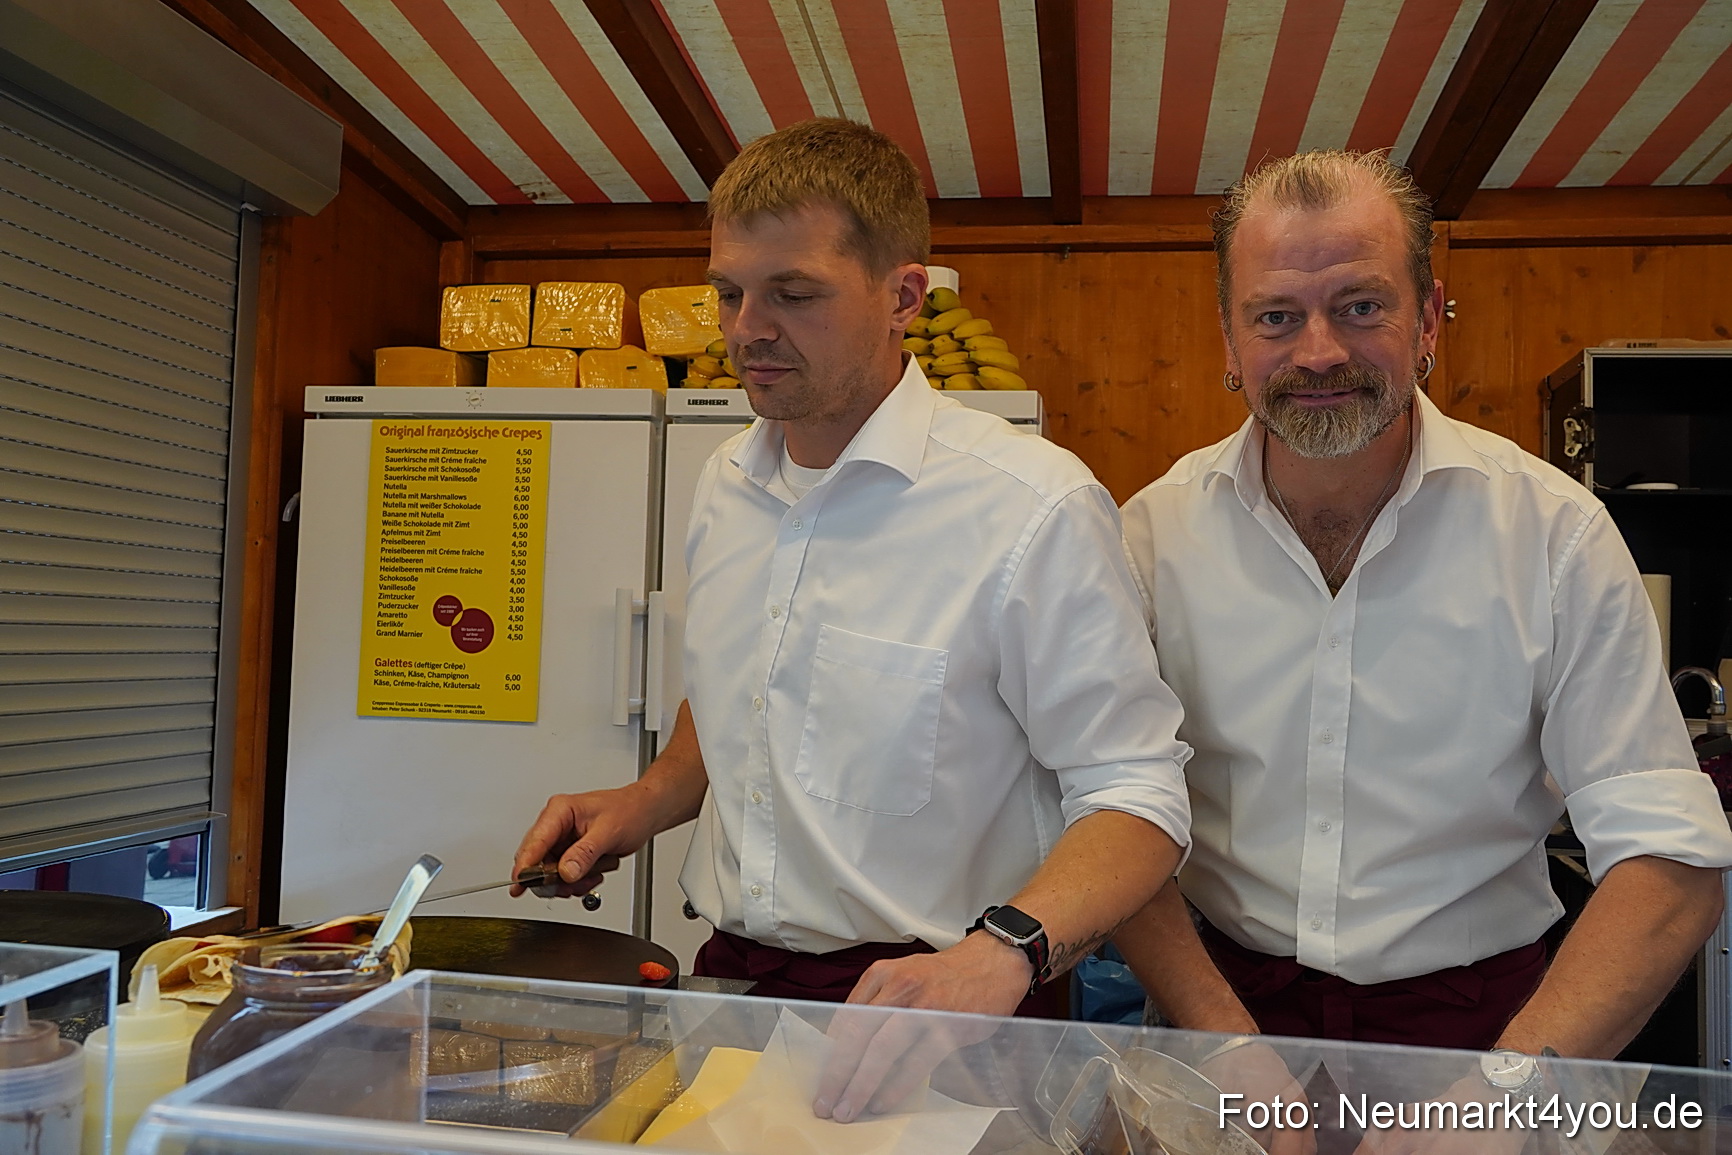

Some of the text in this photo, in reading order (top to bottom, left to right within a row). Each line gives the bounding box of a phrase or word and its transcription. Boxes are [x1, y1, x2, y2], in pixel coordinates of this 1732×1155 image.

[380, 425, 542, 441] Original französische Crepes
[381, 529, 412, 537] Apfelmus
[511, 559, 526, 567] 4,50
[510, 587, 525, 595] 4,00
[378, 602, 418, 610] Puderzucker
[508, 615, 524, 623] 4,50
[508, 624, 523, 632] 4,50
[375, 658, 466, 670] Galettes (deftiger Crêpe)
[374, 670, 406, 678] Schinken,
[428, 672, 468, 680] Champignon
[374, 679, 391, 687] Käse,
[443, 681, 480, 689] Kräutersalz
